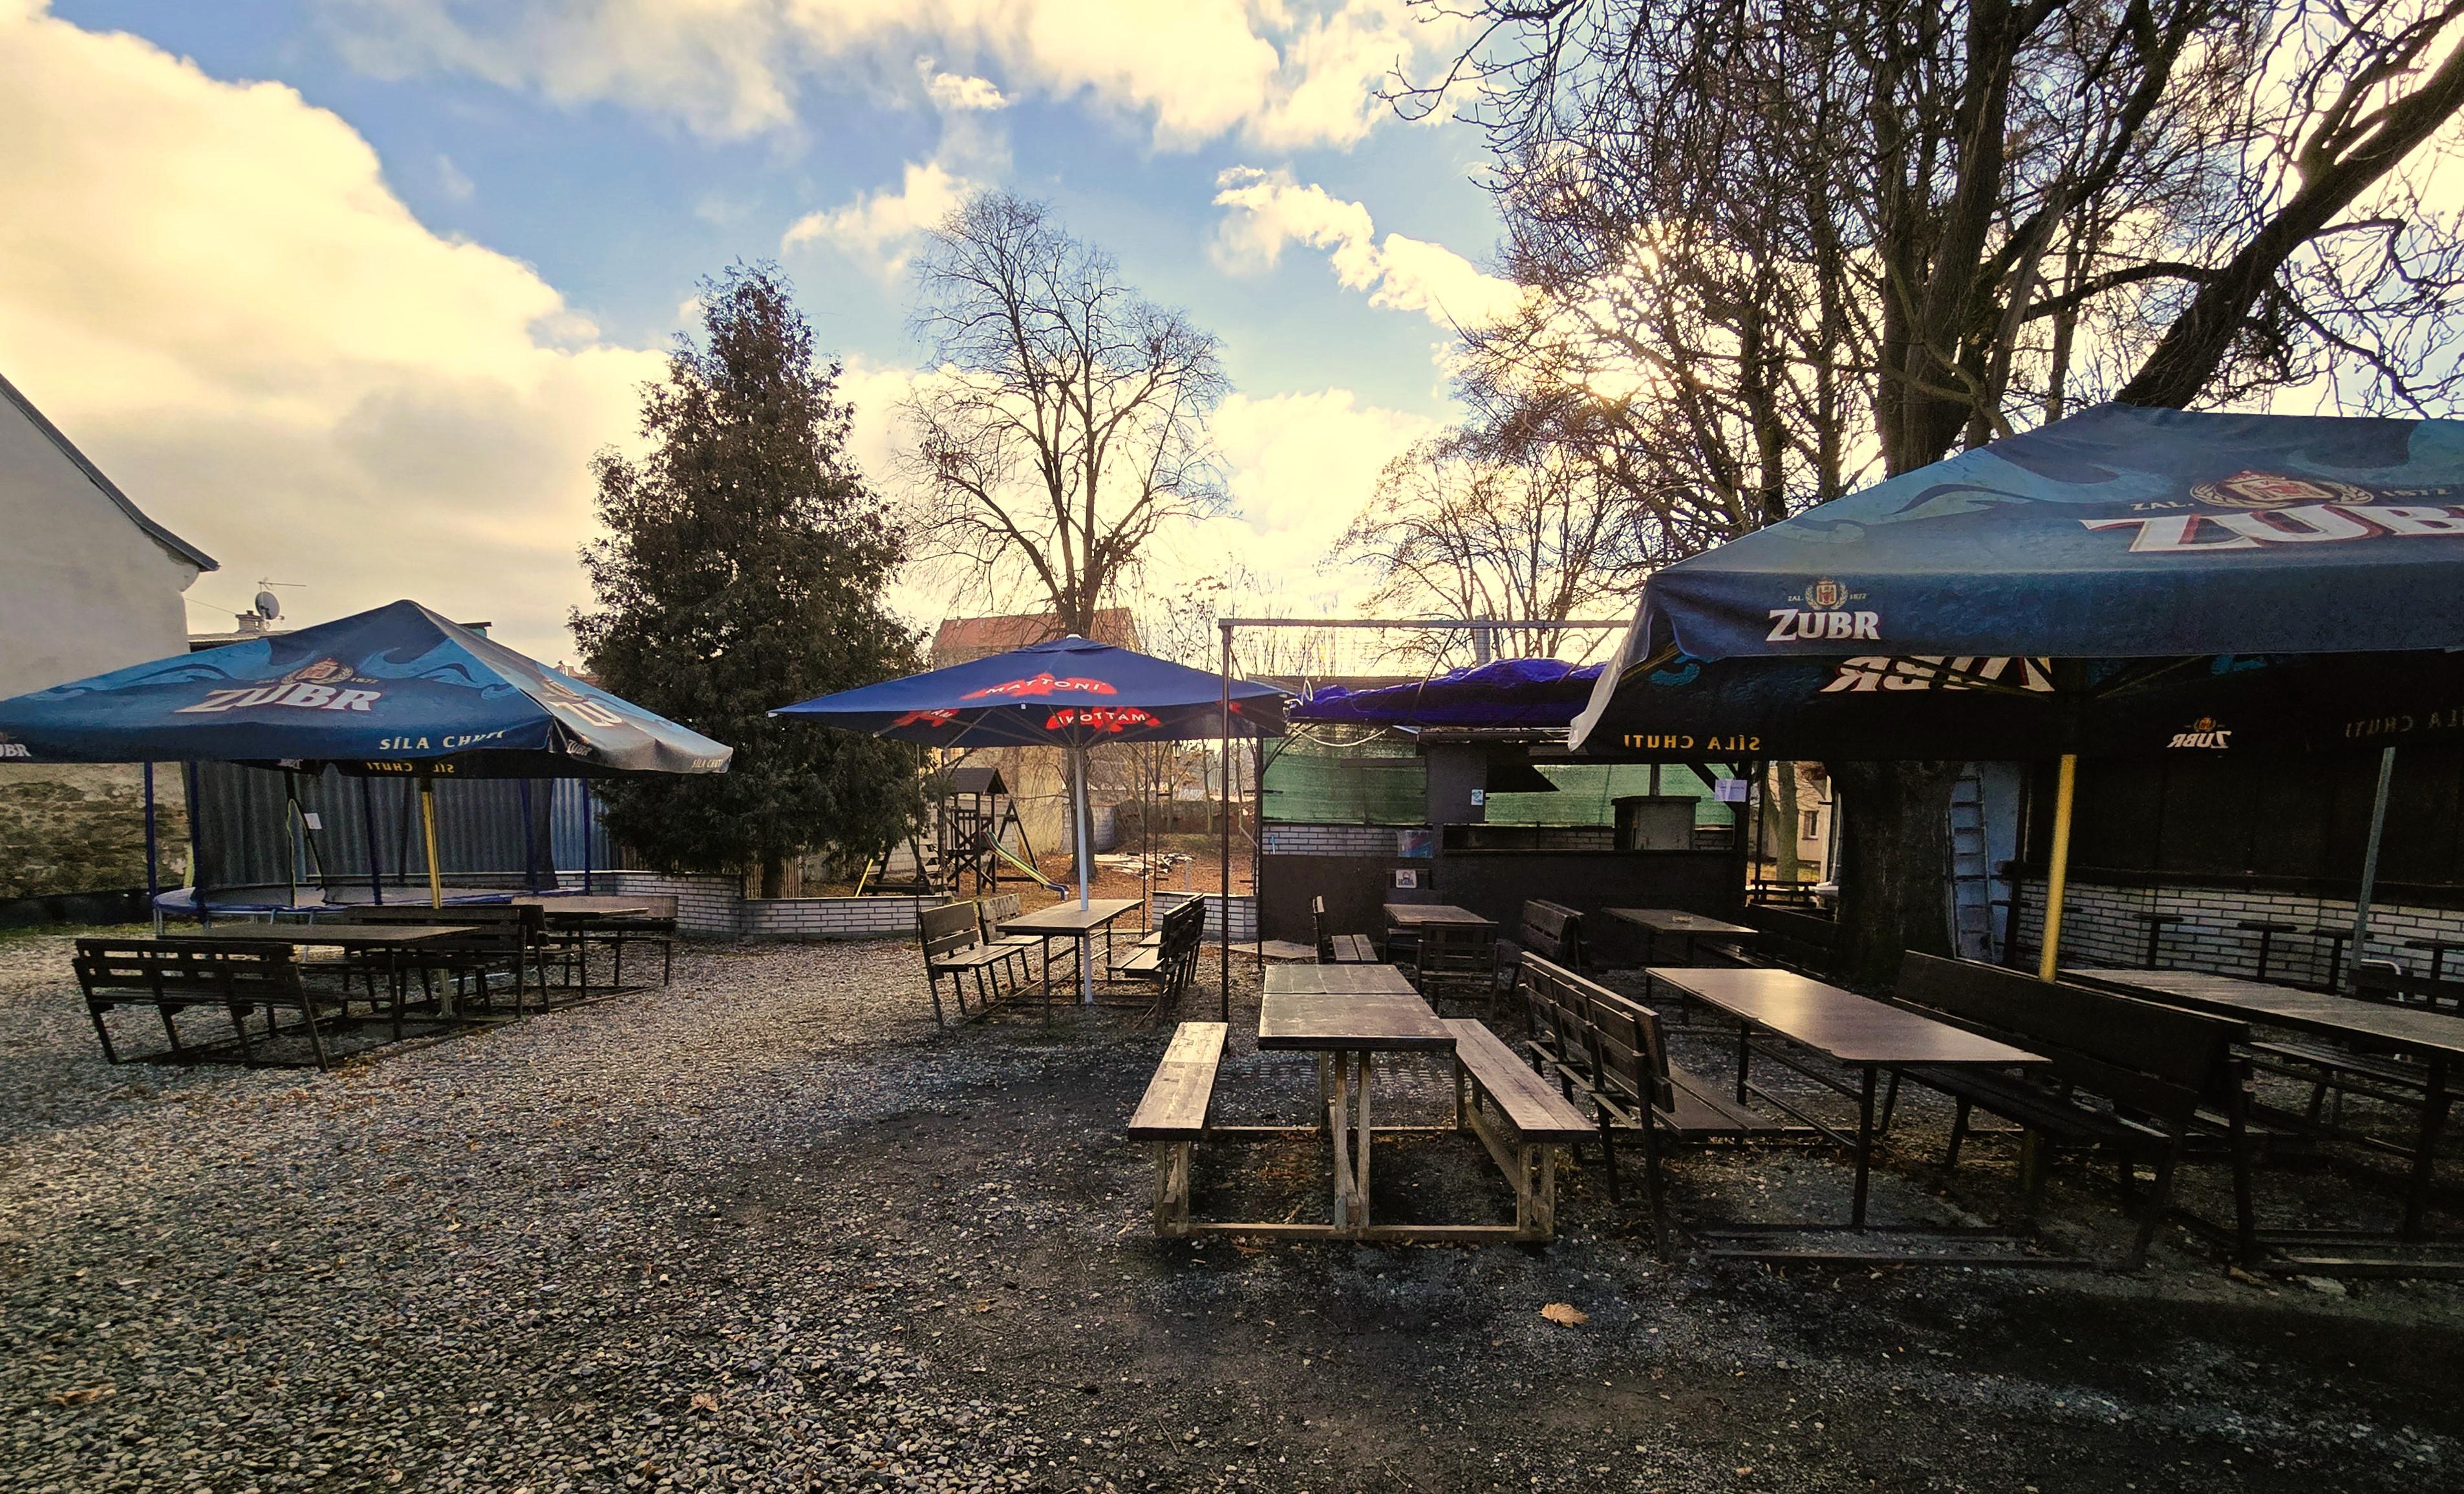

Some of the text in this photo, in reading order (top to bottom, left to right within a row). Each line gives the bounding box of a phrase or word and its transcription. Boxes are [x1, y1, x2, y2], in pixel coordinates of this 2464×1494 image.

[2078, 504, 2464, 552] ZUB
[1765, 609, 1881, 642] ZUBR
[173, 682, 381, 713] ZUBR
[985, 678, 1099, 694] MATTONI
[379, 736, 430, 750] SÍLA
[566, 739, 593, 756] ZUBR
